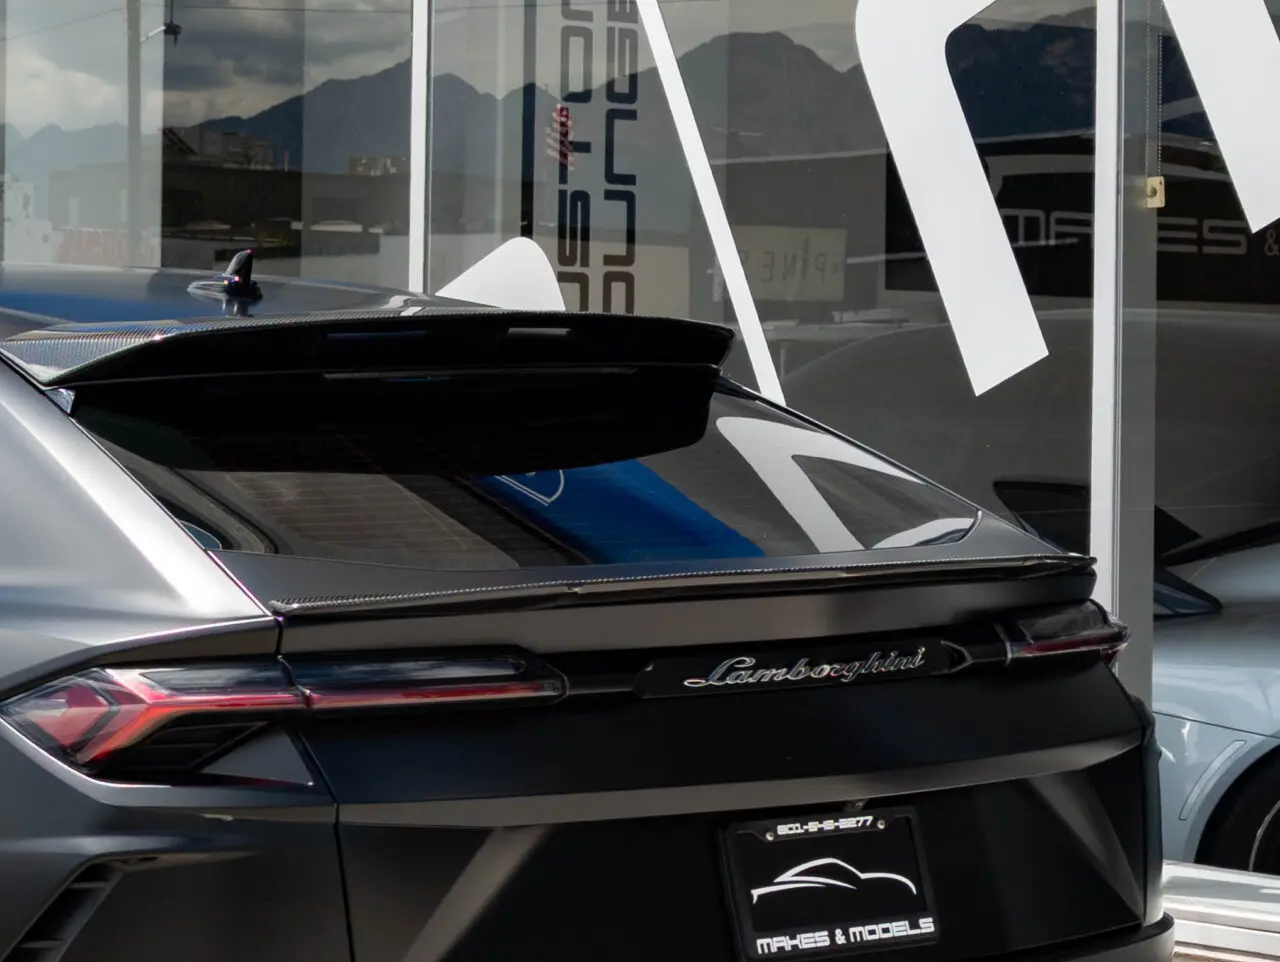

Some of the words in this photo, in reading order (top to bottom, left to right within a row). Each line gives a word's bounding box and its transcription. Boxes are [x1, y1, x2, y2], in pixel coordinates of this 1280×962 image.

[1001, 208, 1247, 255] MAES
[684, 647, 925, 688] Lamborghini
[756, 930, 830, 955] MAKES
[835, 928, 847, 945] &
[849, 917, 935, 942] MODELS
